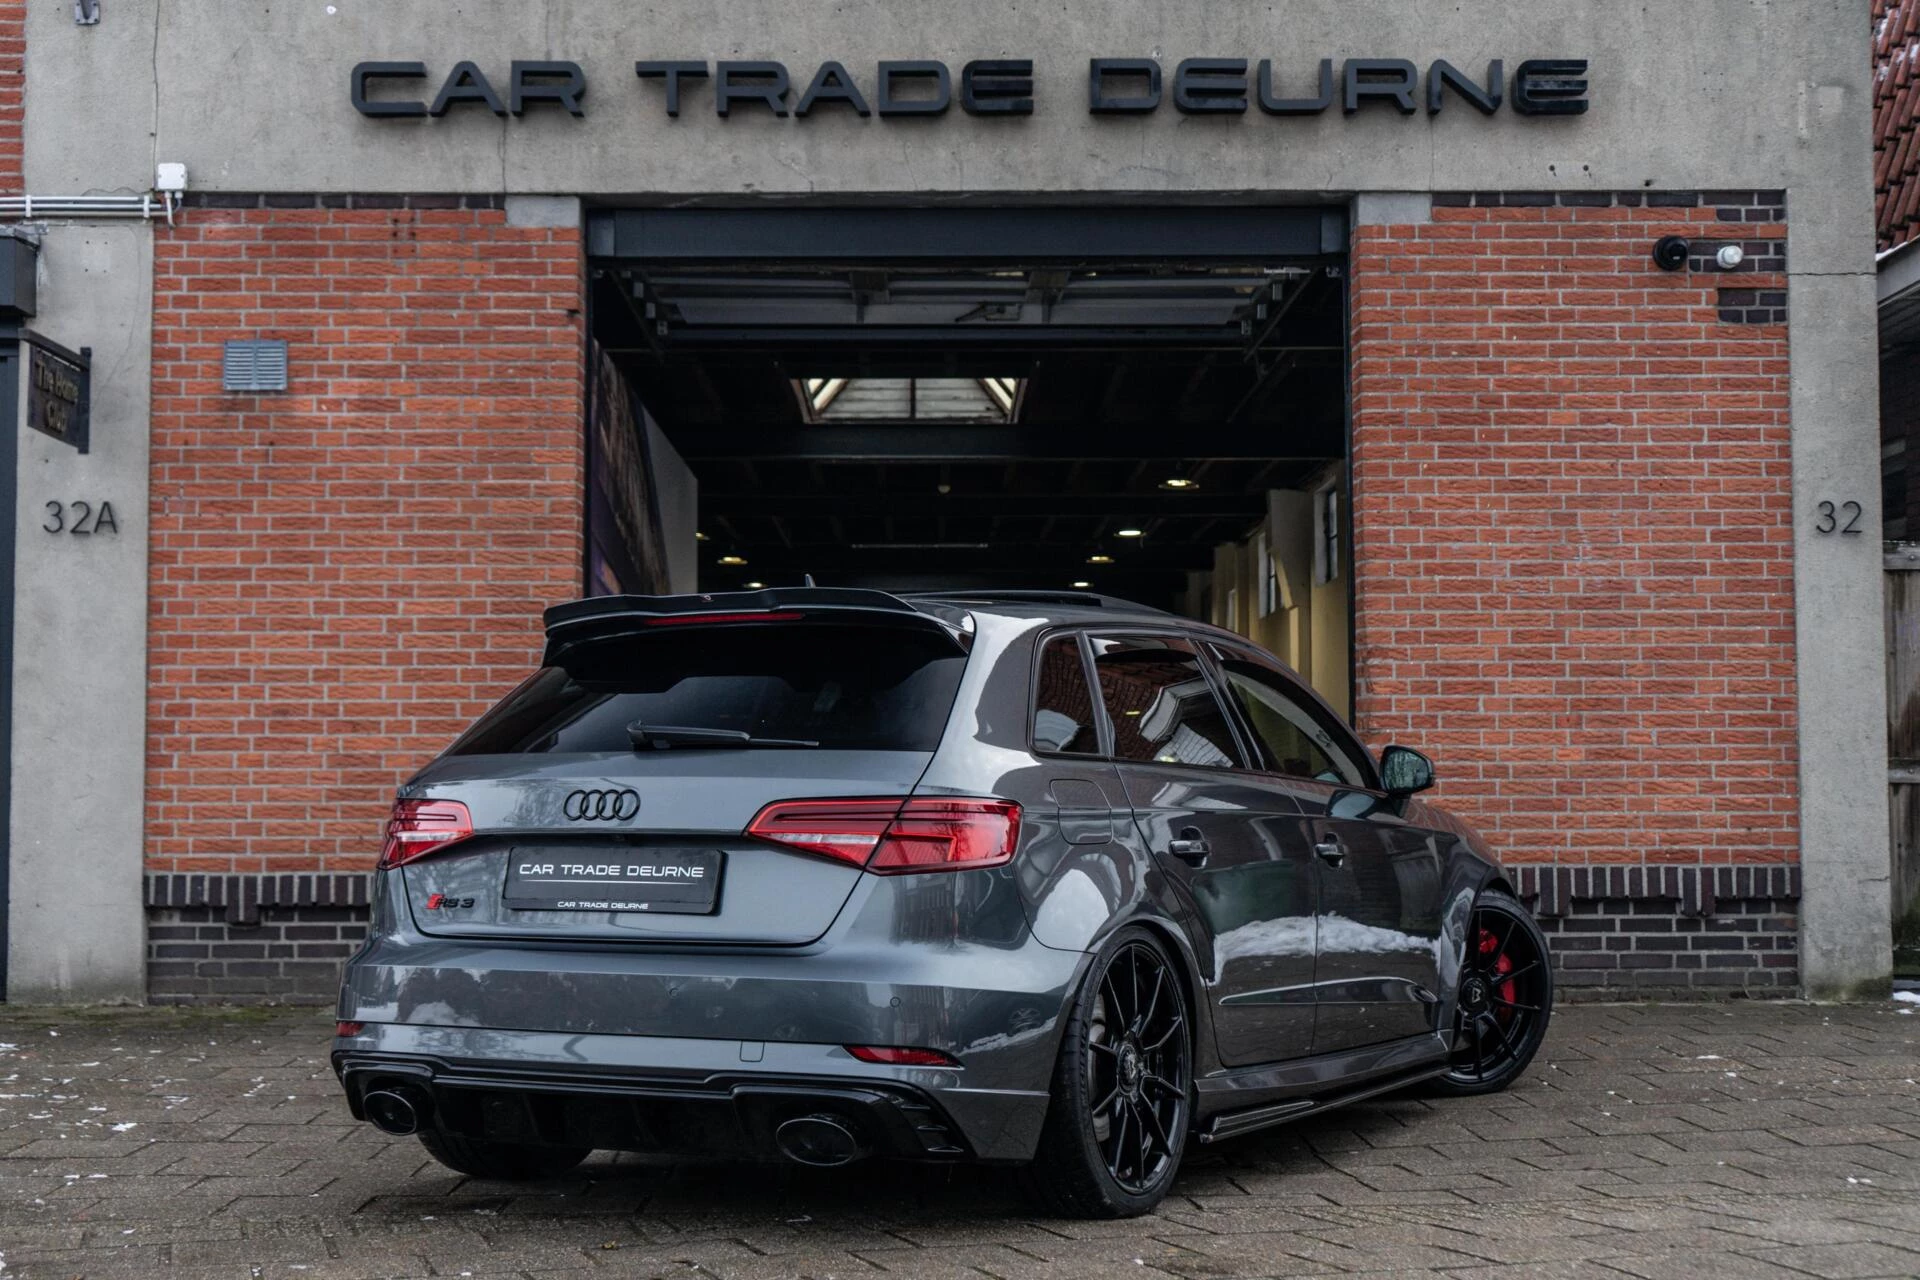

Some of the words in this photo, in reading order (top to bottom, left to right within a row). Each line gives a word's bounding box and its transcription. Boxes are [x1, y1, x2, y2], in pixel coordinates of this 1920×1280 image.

[350, 60, 587, 118] CAR
[635, 59, 1034, 118] TRADE
[1089, 58, 1589, 117] DEURNE
[43, 500, 118, 535] 32A
[1816, 500, 1863, 535] 32
[519, 864, 555, 876] CAR
[561, 864, 621, 877] TRADE
[626, 865, 705, 879] DEURNE
[557, 901, 577, 909] CAR
[578, 902, 609, 910] TRADE
[610, 902, 649, 910] DEURNE
